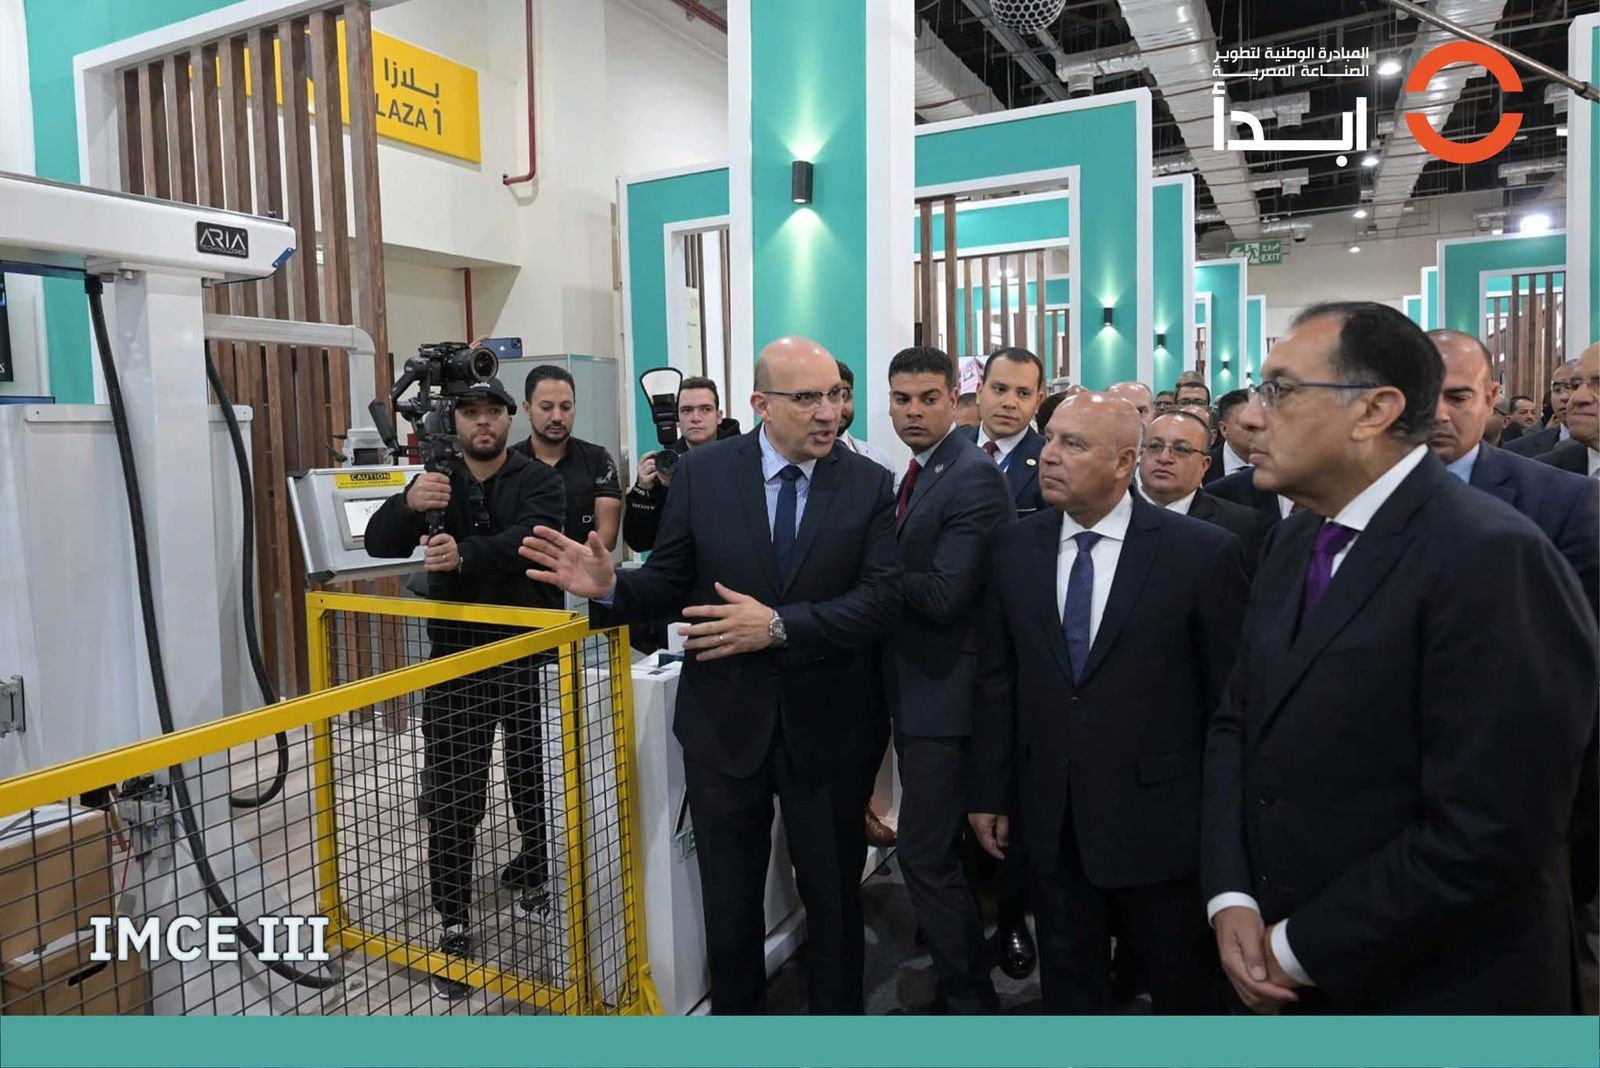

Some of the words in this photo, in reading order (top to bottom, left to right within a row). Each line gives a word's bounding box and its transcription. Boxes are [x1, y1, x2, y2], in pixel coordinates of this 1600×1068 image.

[383, 57, 440, 105] بلازا
[375, 92, 428, 131] LAZA
[433, 108, 442, 136] 1
[199, 227, 246, 251] ARIA
[1261, 253, 1280, 262] EXIT
[350, 472, 391, 481] CAUTION
